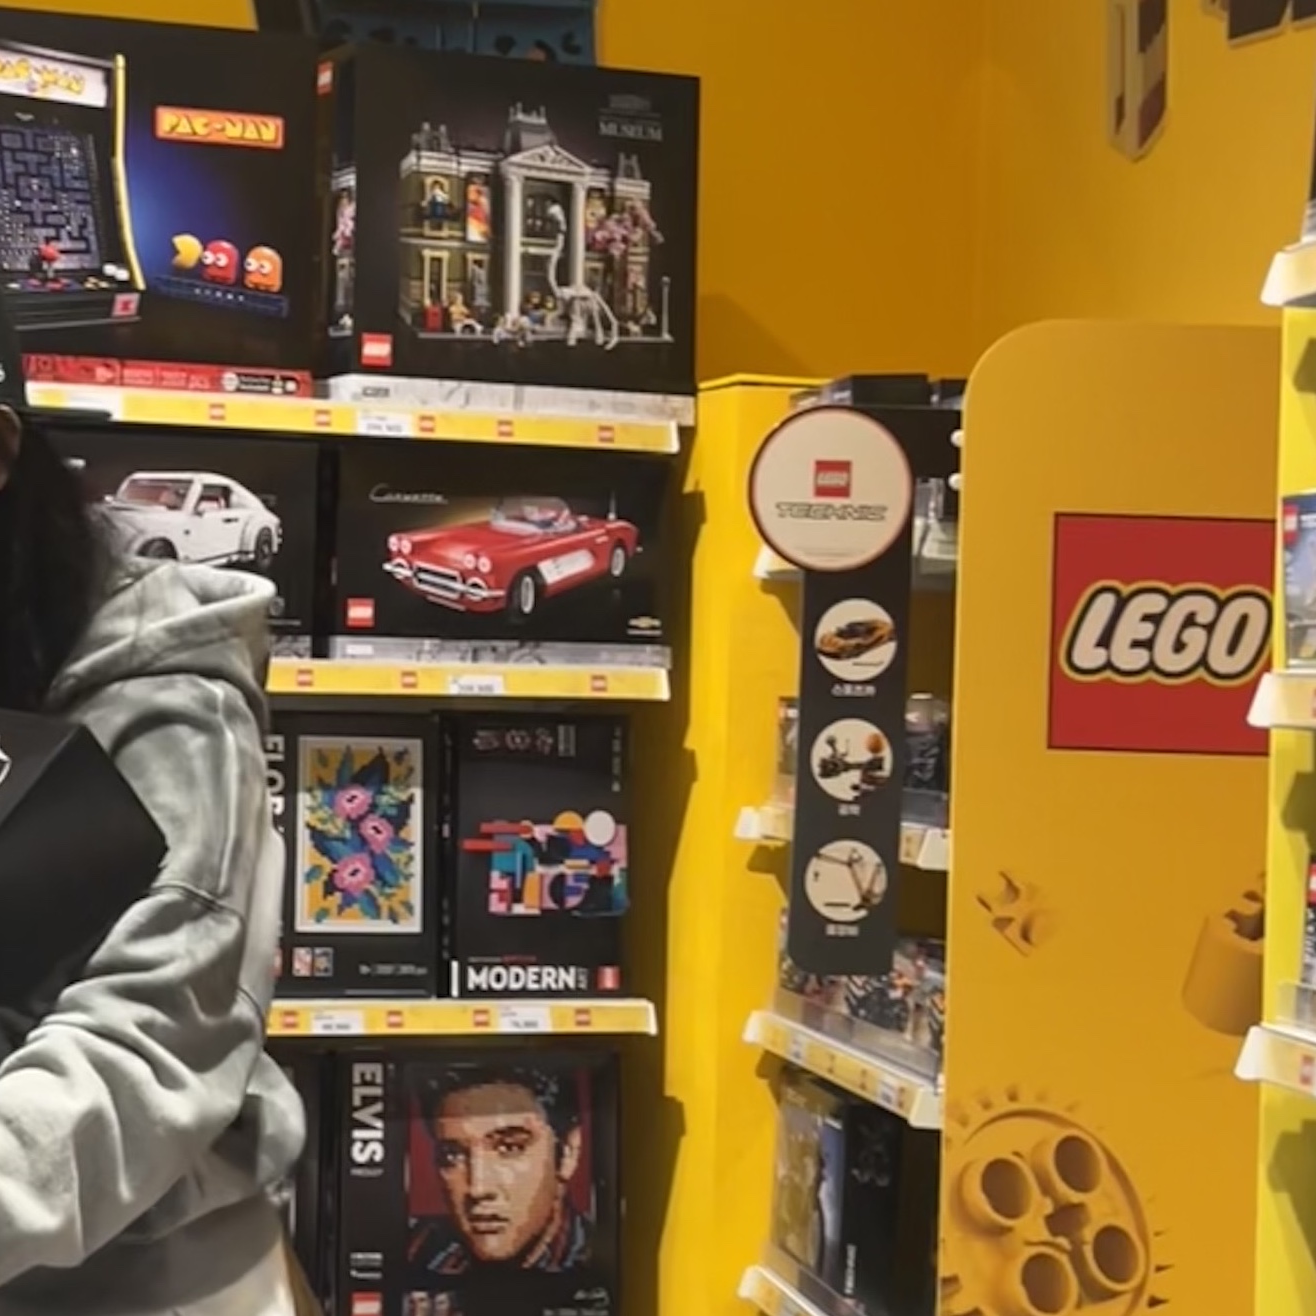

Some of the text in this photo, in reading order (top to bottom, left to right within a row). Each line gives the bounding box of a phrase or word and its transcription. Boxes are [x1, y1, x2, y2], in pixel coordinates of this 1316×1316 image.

[163, 112, 279, 142] PAC-MAN
[598, 121, 663, 142] MUSEUM
[774, 502, 888, 522] TECHNIC
[1064, 584, 1273, 681] LEGO
[466, 965, 576, 991] MODERN
[351, 1062, 384, 1164] ELVIS
